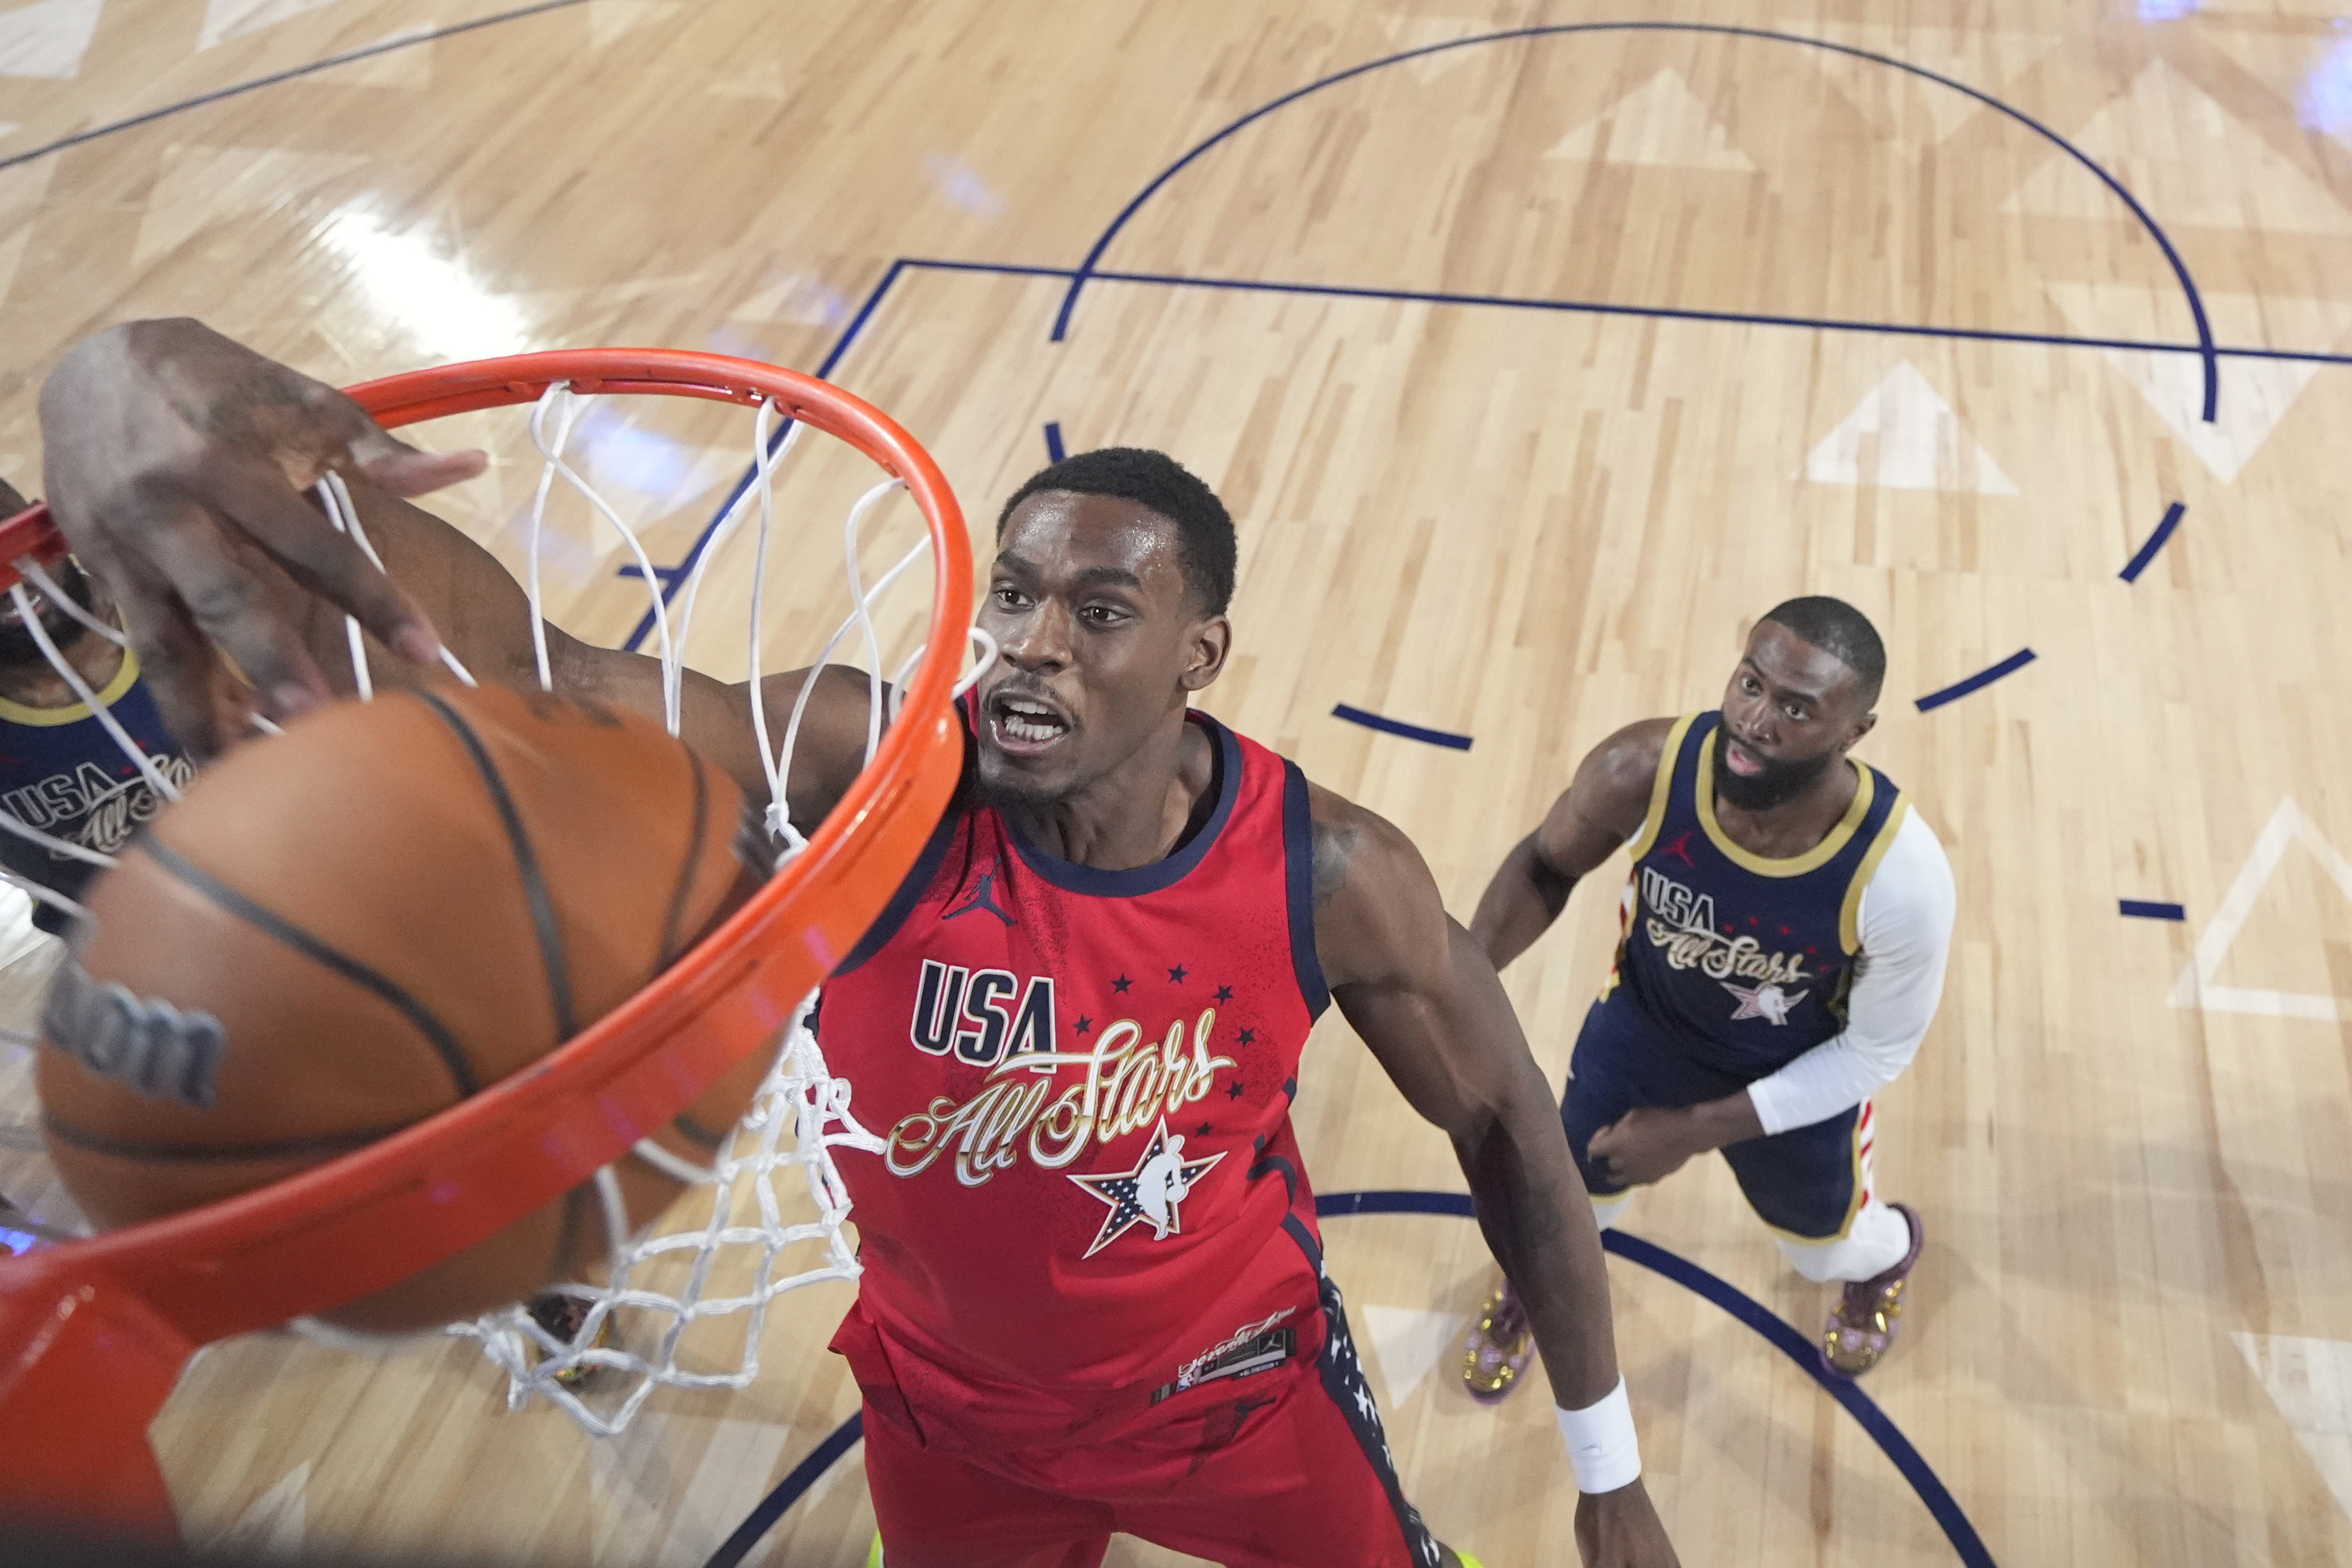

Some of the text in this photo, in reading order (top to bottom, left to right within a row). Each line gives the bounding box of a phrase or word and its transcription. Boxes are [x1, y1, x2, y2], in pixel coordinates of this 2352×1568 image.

[2, 761, 121, 830] USA
[1642, 866, 1714, 933] USA
[1646, 918, 1812, 983] All Stars
[910, 959, 1058, 1074] USA
[885, 1007, 1237, 1188] All Stars
